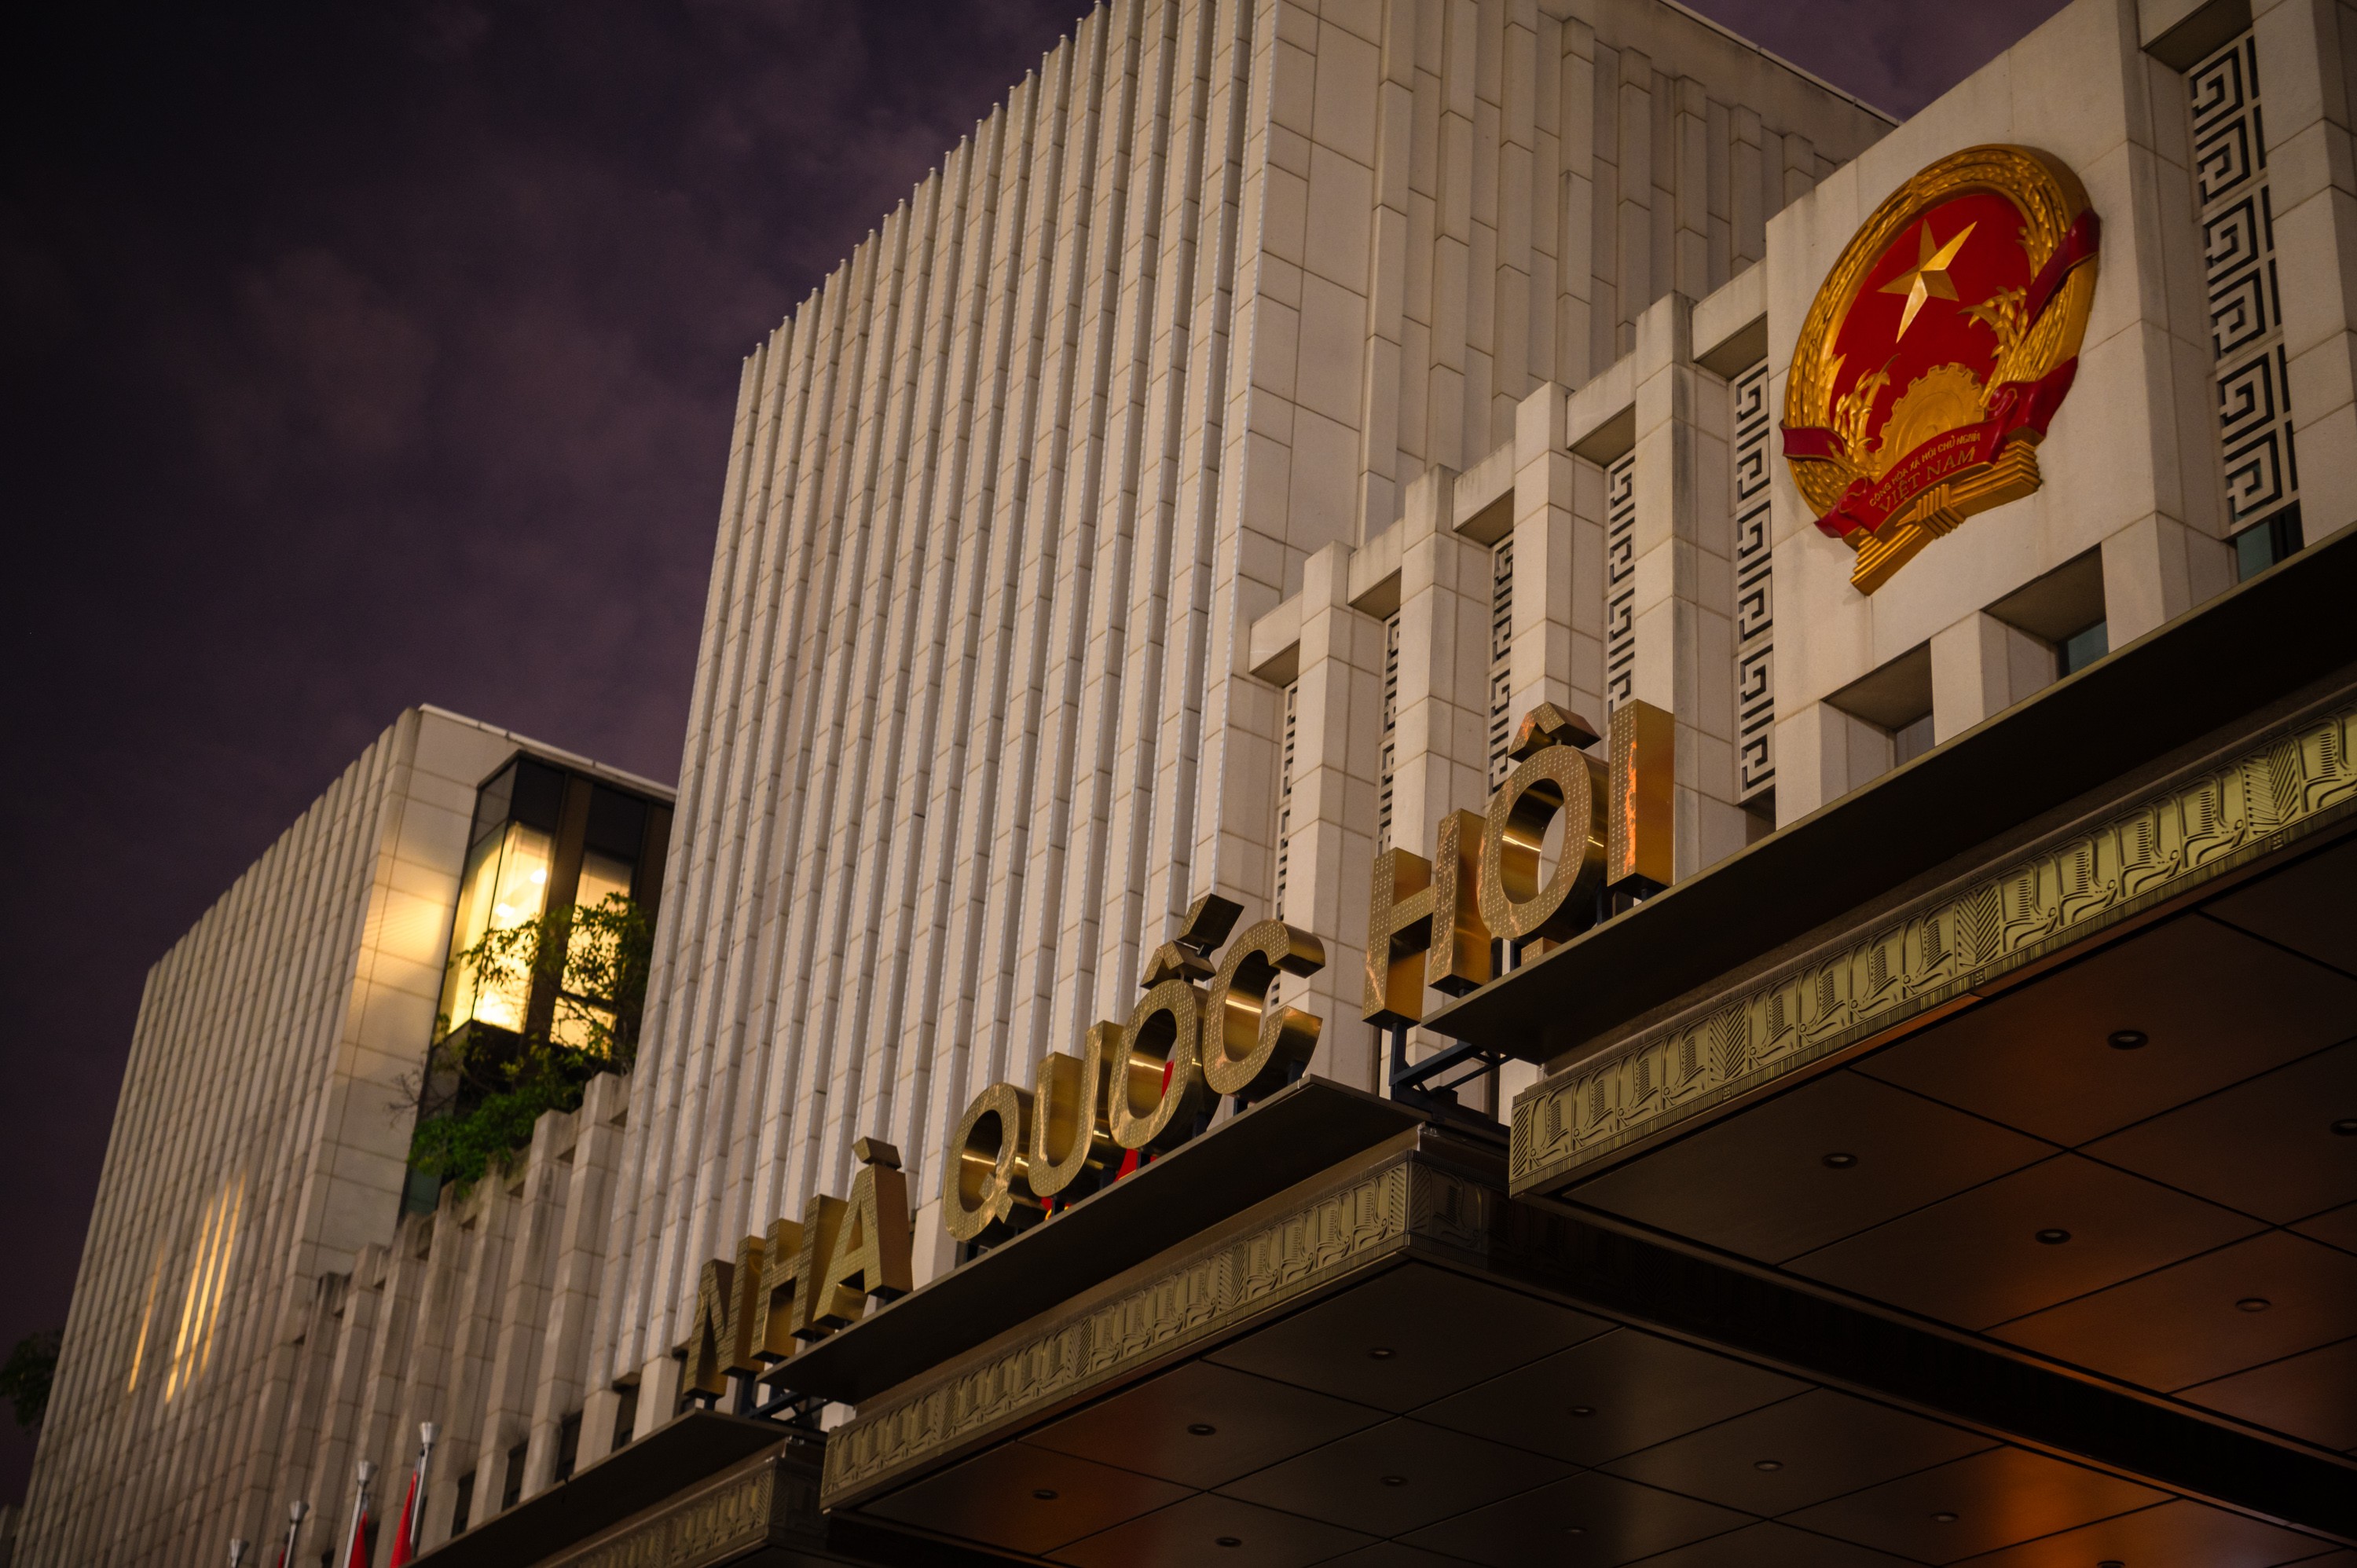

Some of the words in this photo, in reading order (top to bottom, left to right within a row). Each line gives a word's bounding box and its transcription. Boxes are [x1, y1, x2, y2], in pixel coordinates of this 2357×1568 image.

[1879, 472, 1920, 512] VIỆT
[1926, 445, 1976, 481] NAM
[1910, 456, 1920, 471] XÃ
[1922, 447, 1937, 463] HỘI
[1937, 434, 1956, 453] CHỦ
[1956, 430, 1981, 445] NGHĨA
[683, 1136, 913, 1400] NHÀ
[944, 893, 1326, 1243] QUỐC
[1362, 701, 1675, 1023] HỘI
